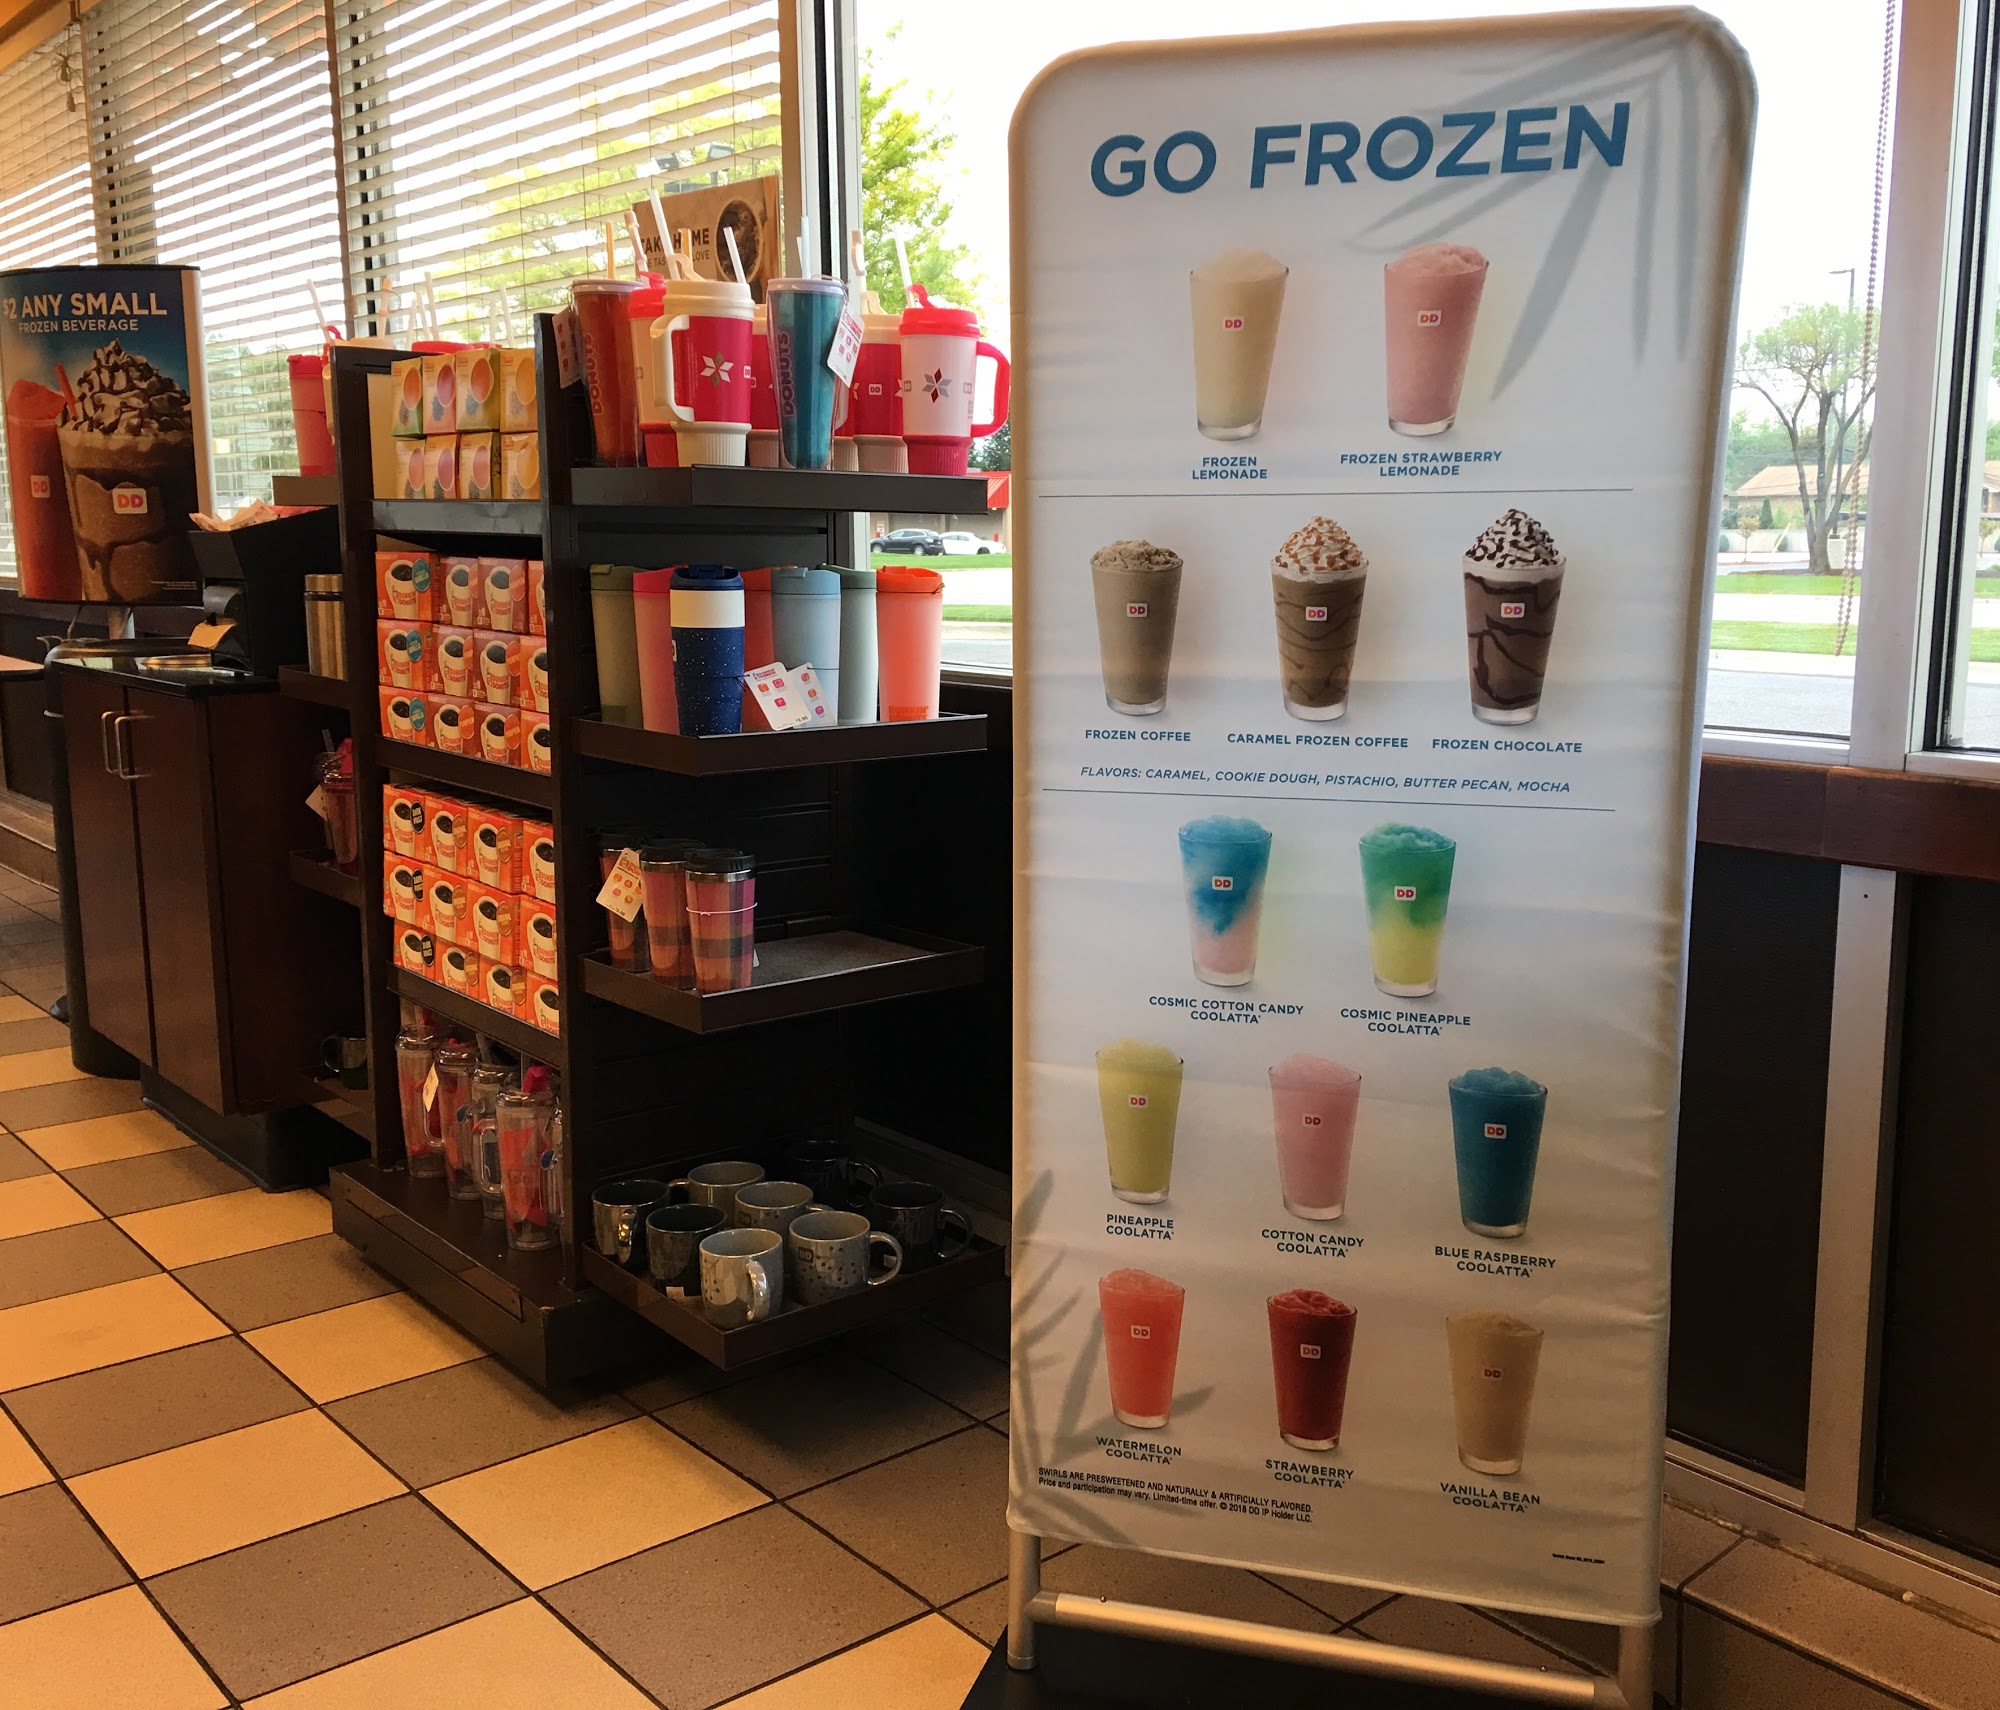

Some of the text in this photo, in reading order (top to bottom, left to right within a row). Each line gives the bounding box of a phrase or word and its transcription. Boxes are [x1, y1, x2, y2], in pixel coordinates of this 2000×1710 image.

[1091, 102, 1630, 197] GO FROZEN
[640, 228, 709, 254] TAK HME
[3, 292, 167, 319] $2 ANY SMALL
[1225, 319, 1242, 328] DD
[1420, 313, 1439, 323] DD
[18, 318, 139, 334] FROZEN BEVERAGE
[1202, 456, 1257, 468] FROZEN
[1340, 450, 1503, 465] FROZEN STRAWBERRY
[1192, 468, 1268, 480] LEMONADE
[1379, 464, 1460, 477] LEMONADE
[117, 493, 144, 508] DD
[1129, 606, 1145, 615] DD
[1309, 609, 1325, 618] DD
[1504, 606, 1522, 615] DD
[1085, 729, 1191, 742] FROZEN COFFEE
[1227, 733, 1409, 748] CARAMEL FROZEN COFFEE
[1432, 738, 1583, 753] FROZEN CHOCOLATE
[1080, 766, 1570, 793] FLAVORS: CARAMEL, COOKIE DOUGH, PISTACHIO, BUTTER PECAN, MOCHA
[1214, 879, 1231, 888] DD
[1397, 889, 1414, 898] DD
[1148, 995, 1304, 1015] COSMIC COTTON CANDY
[1340, 1008, 1471, 1026] COSMIC PINEAPPLE
[1130, 1096, 1147, 1106] DD
[1305, 1116, 1321, 1126] DD
[1487, 1126, 1505, 1136] DD
[1106, 1213, 1174, 1229] PINEAPPLE
[1261, 1228, 1365, 1248] COTTON CANDY
[1434, 1245, 1557, 1269] BLUE RASPBERRY
[1133, 1327, 1149, 1336] DD
[1302, 1347, 1319, 1356] DD
[1484, 1368, 1501, 1378] DD
[1095, 1436, 1182, 1457] WATERMELON
[1265, 1458, 1354, 1480] STRAWBERRY
[1038, 1466, 1314, 1514] SWIRLS ARE PRESWEETENED AND NATURALLY & ARTIFICIALLY FLAVORED.
[1440, 1482, 1540, 1505] VANILLA BEAN
[1038, 1477, 1057, 1487] Price
[1057, 1480, 1071, 1489] and
[1072, 1481, 1116, 1496] participation
[1117, 1487, 1133, 1498] may
[1134, 1490, 1151, 1501] vary.
[1152, 1491, 1198, 1506] Limited-time
[1199, 1499, 1218, 1510] offer.
[1228, 1502, 1247, 1513] 2018
[1248, 1504, 1260, 1515] DD
[1261, 1507, 1269, 1516] IP
[1271, 1508, 1295, 1520] Holder
[1296, 1513, 1313, 1523] LLC.
